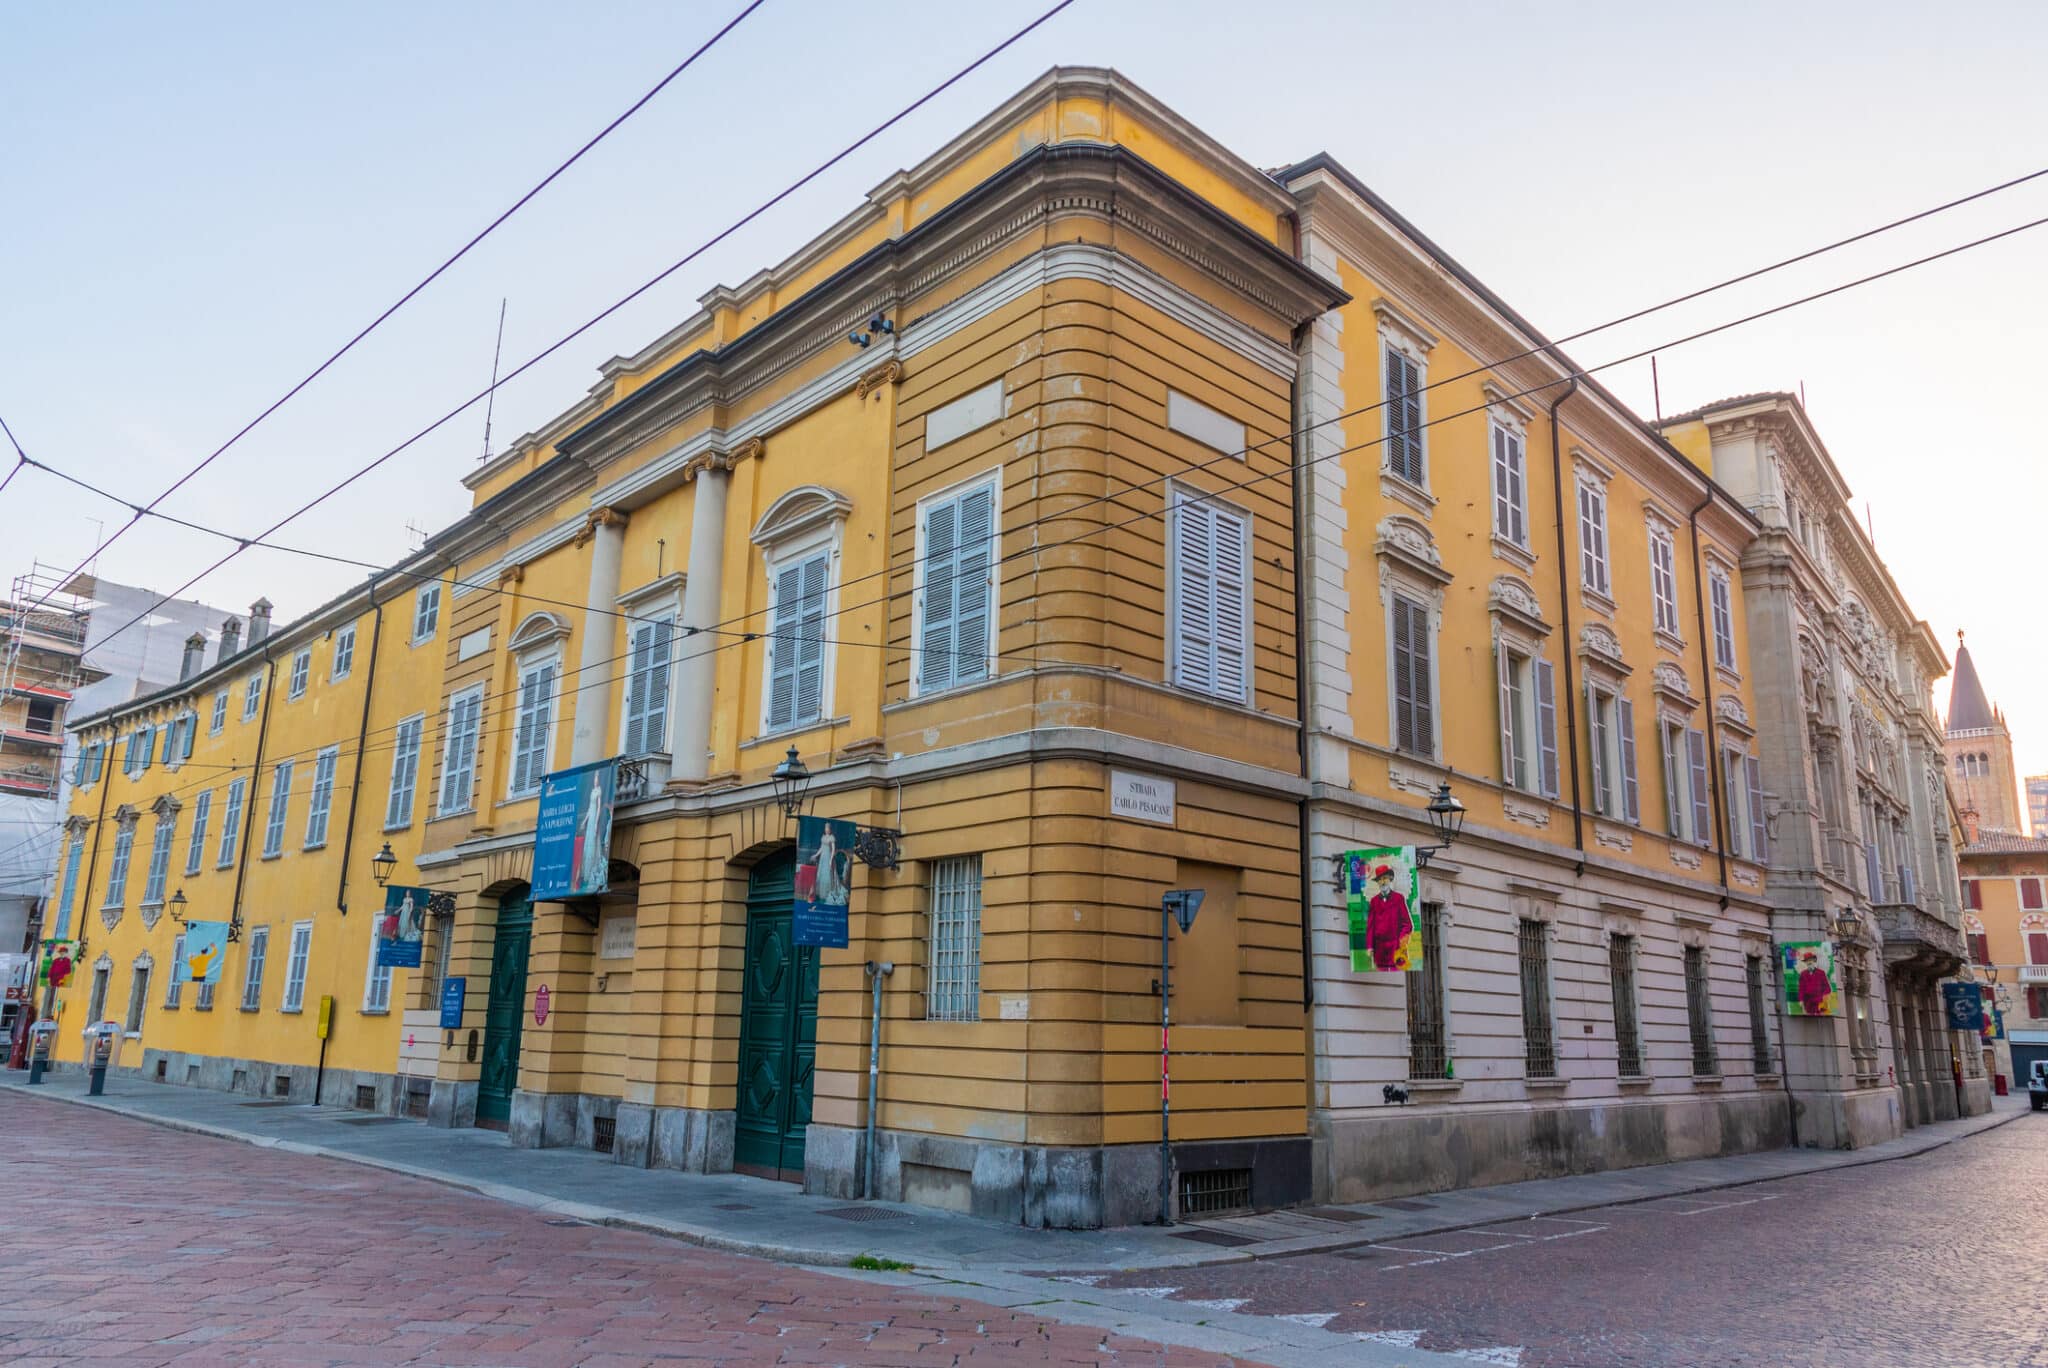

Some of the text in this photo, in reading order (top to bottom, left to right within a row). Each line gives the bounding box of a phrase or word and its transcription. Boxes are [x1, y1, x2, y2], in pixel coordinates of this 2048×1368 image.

[1129, 782, 1156, 797] STRADA
[1114, 797, 1170, 816] CARLO PISACANE
